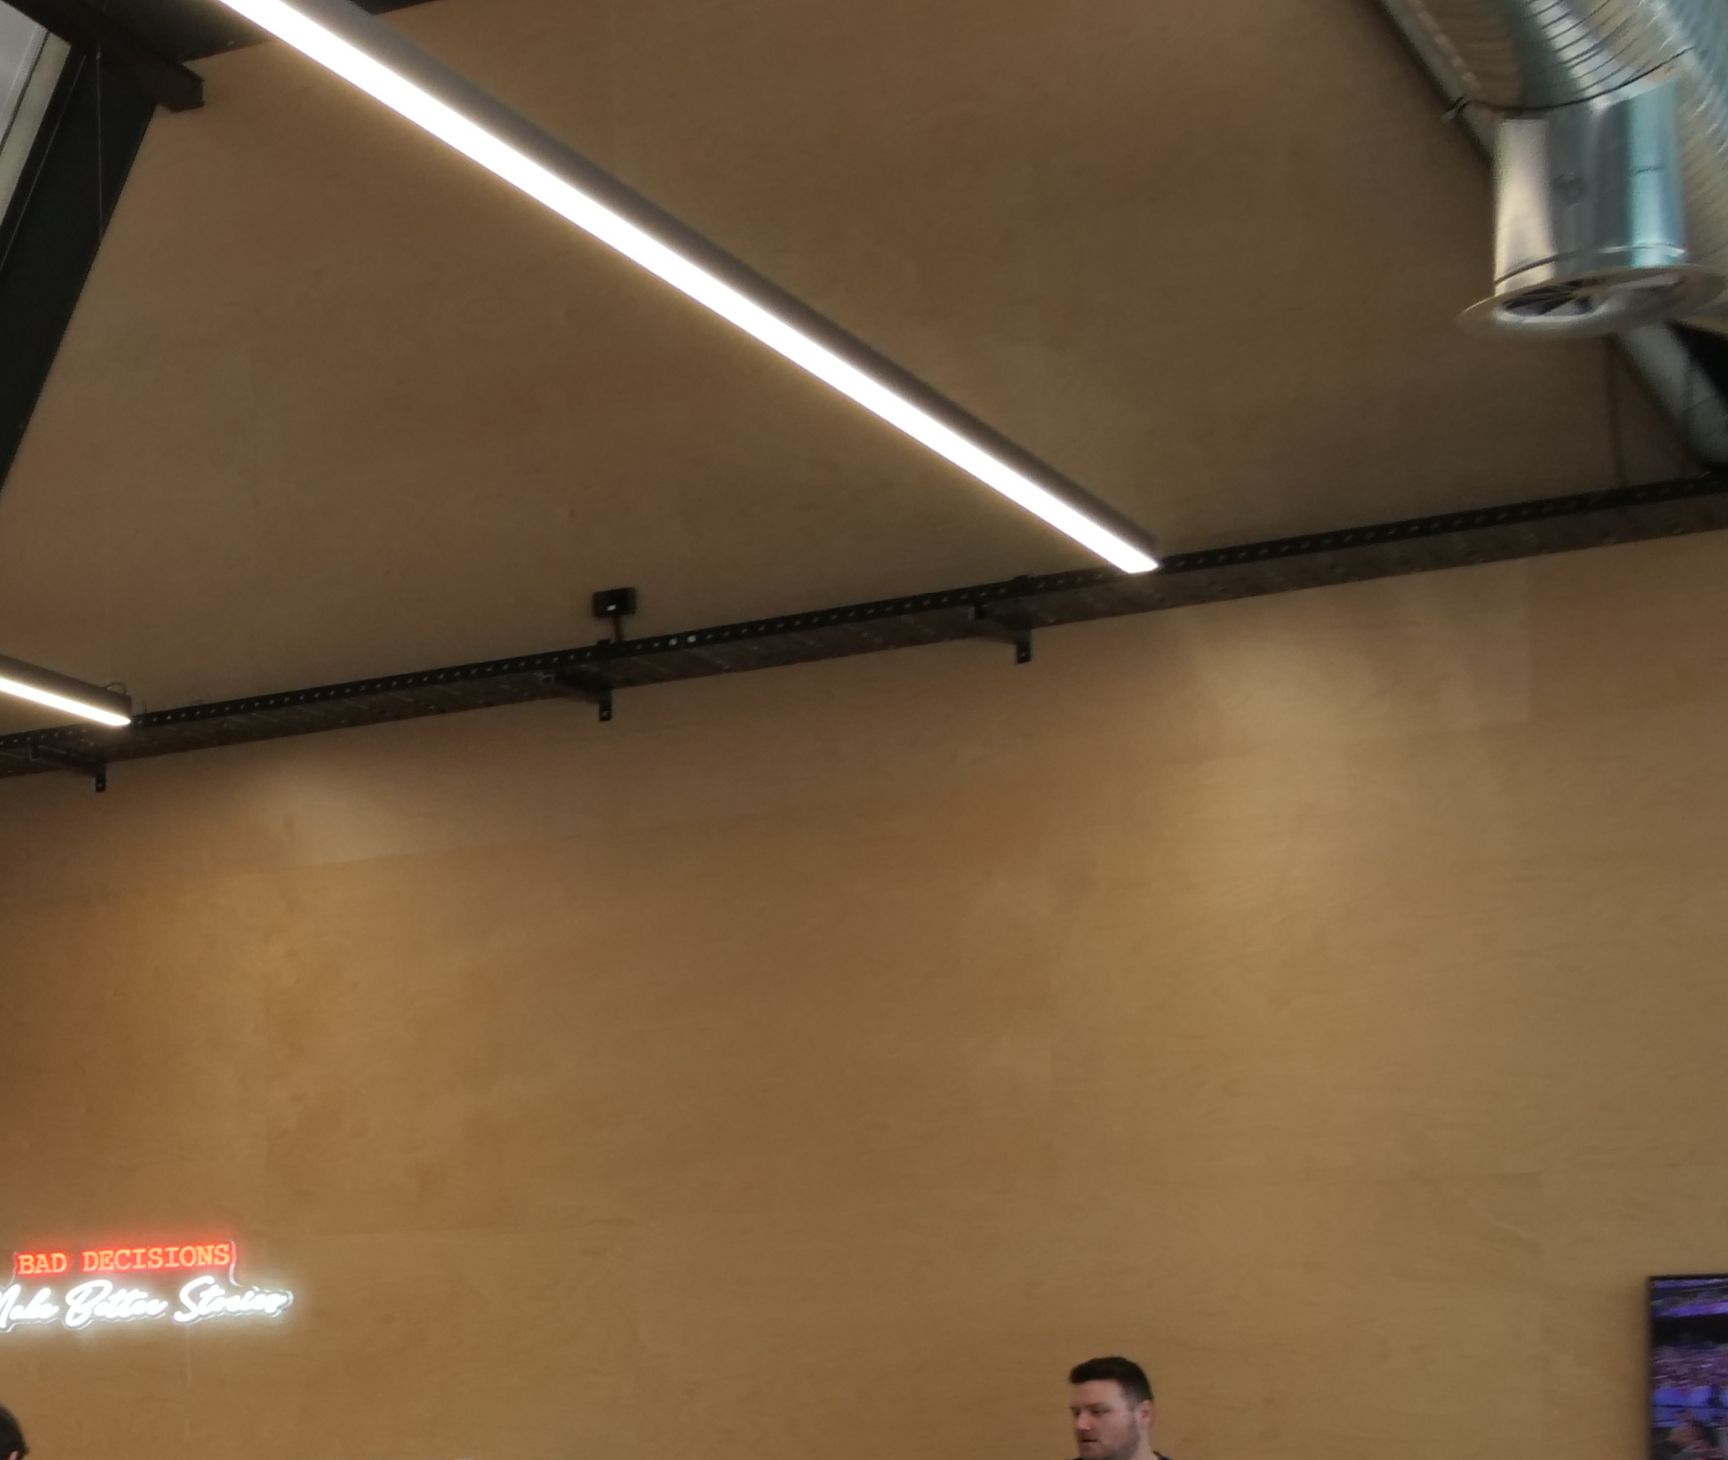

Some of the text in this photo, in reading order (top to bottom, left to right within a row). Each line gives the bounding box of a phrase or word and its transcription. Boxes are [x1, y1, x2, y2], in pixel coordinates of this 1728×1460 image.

[17, 1244, 231, 1275] BAD DECISIONS
[65, 1279, 168, 1327] Better
[173, 1275, 289, 1323] Stories
